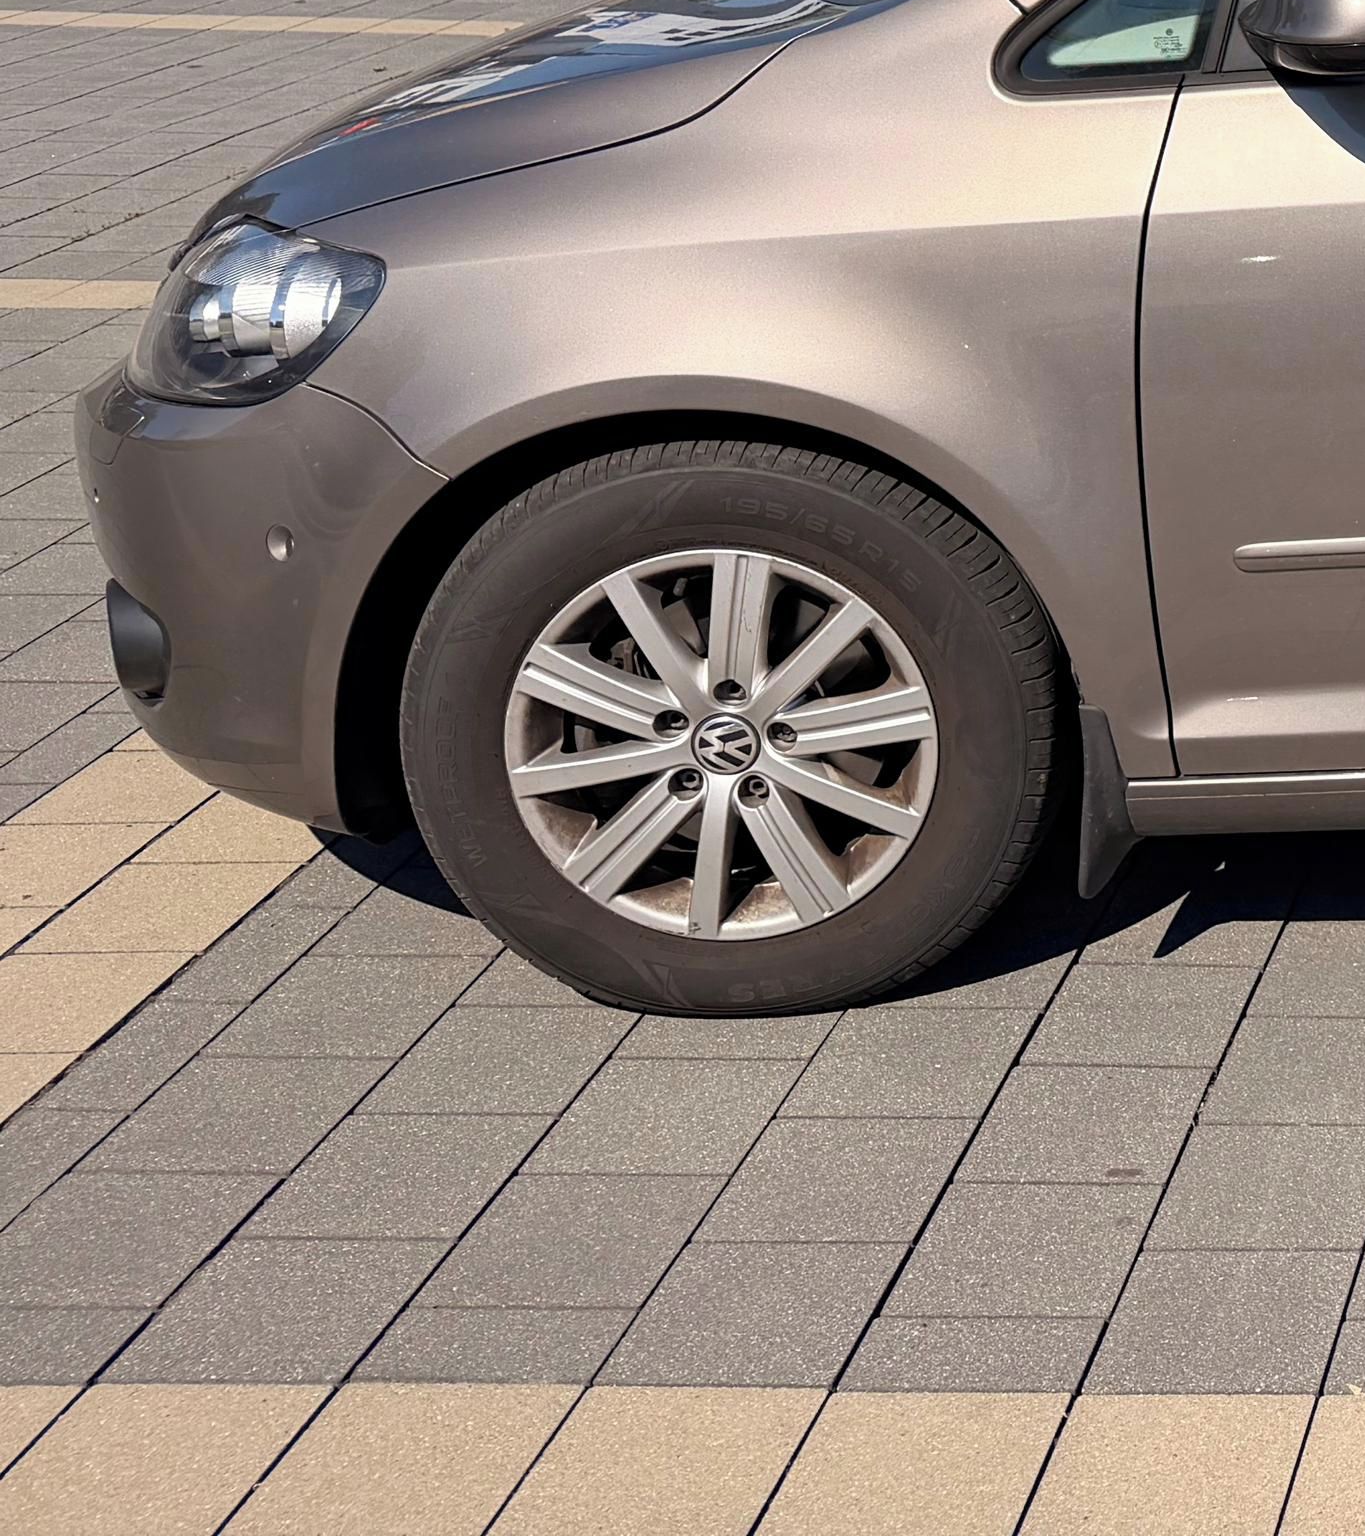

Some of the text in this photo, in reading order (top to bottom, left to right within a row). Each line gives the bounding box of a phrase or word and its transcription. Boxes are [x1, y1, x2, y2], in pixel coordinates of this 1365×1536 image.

[718, 495, 861, 547] 195/65
[857, 538, 925, 593] R15
[434, 695, 489, 870] WETPROOF
